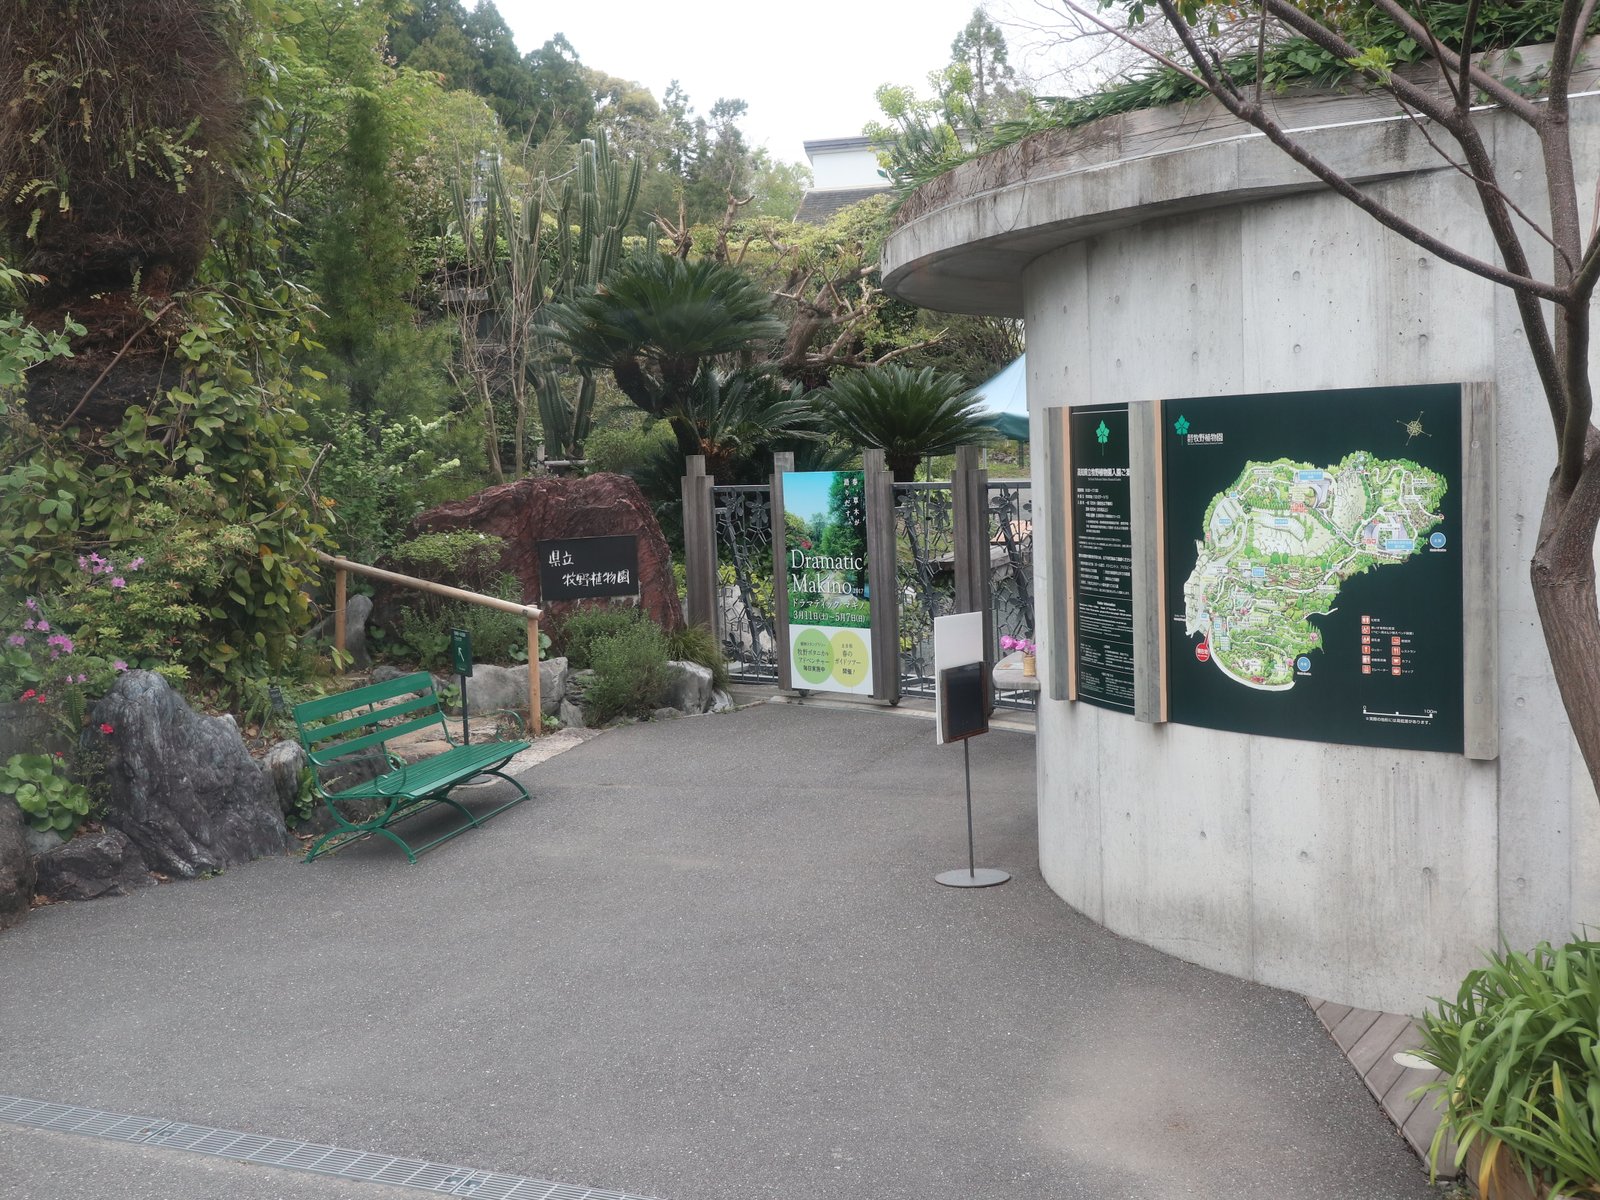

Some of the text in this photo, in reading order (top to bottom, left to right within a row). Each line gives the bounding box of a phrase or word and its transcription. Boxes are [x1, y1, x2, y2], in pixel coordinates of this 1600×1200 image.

[549, 550, 574, 567] 県立
[791, 549, 863, 570] Dramatic
[562, 569, 630, 587] 牧野植物園
[792, 574, 852, 594] Makino
[843, 650, 854, 658] 春の
